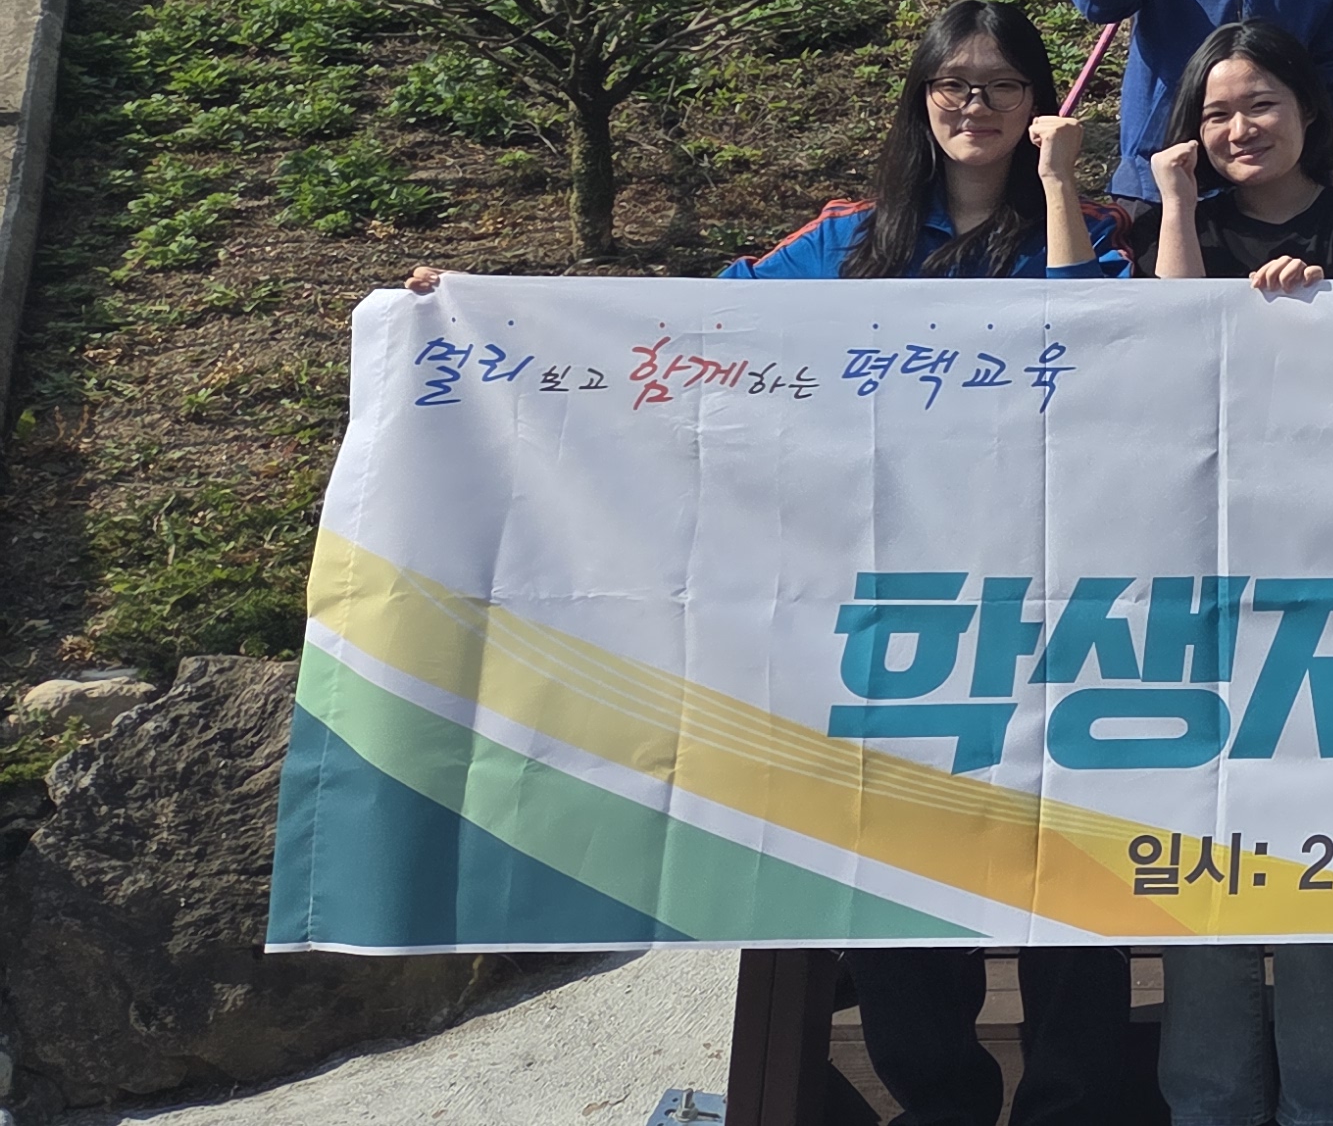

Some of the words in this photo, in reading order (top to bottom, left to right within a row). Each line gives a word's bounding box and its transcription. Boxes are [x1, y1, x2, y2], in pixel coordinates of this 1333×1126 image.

[414, 336, 535, 407] 멀리
[539, 365, 609, 392] 보고
[629, 336, 821, 411] 함께하는
[840, 341, 1077, 414] 평택교육
[1127, 831, 1268, 897] 일시:
